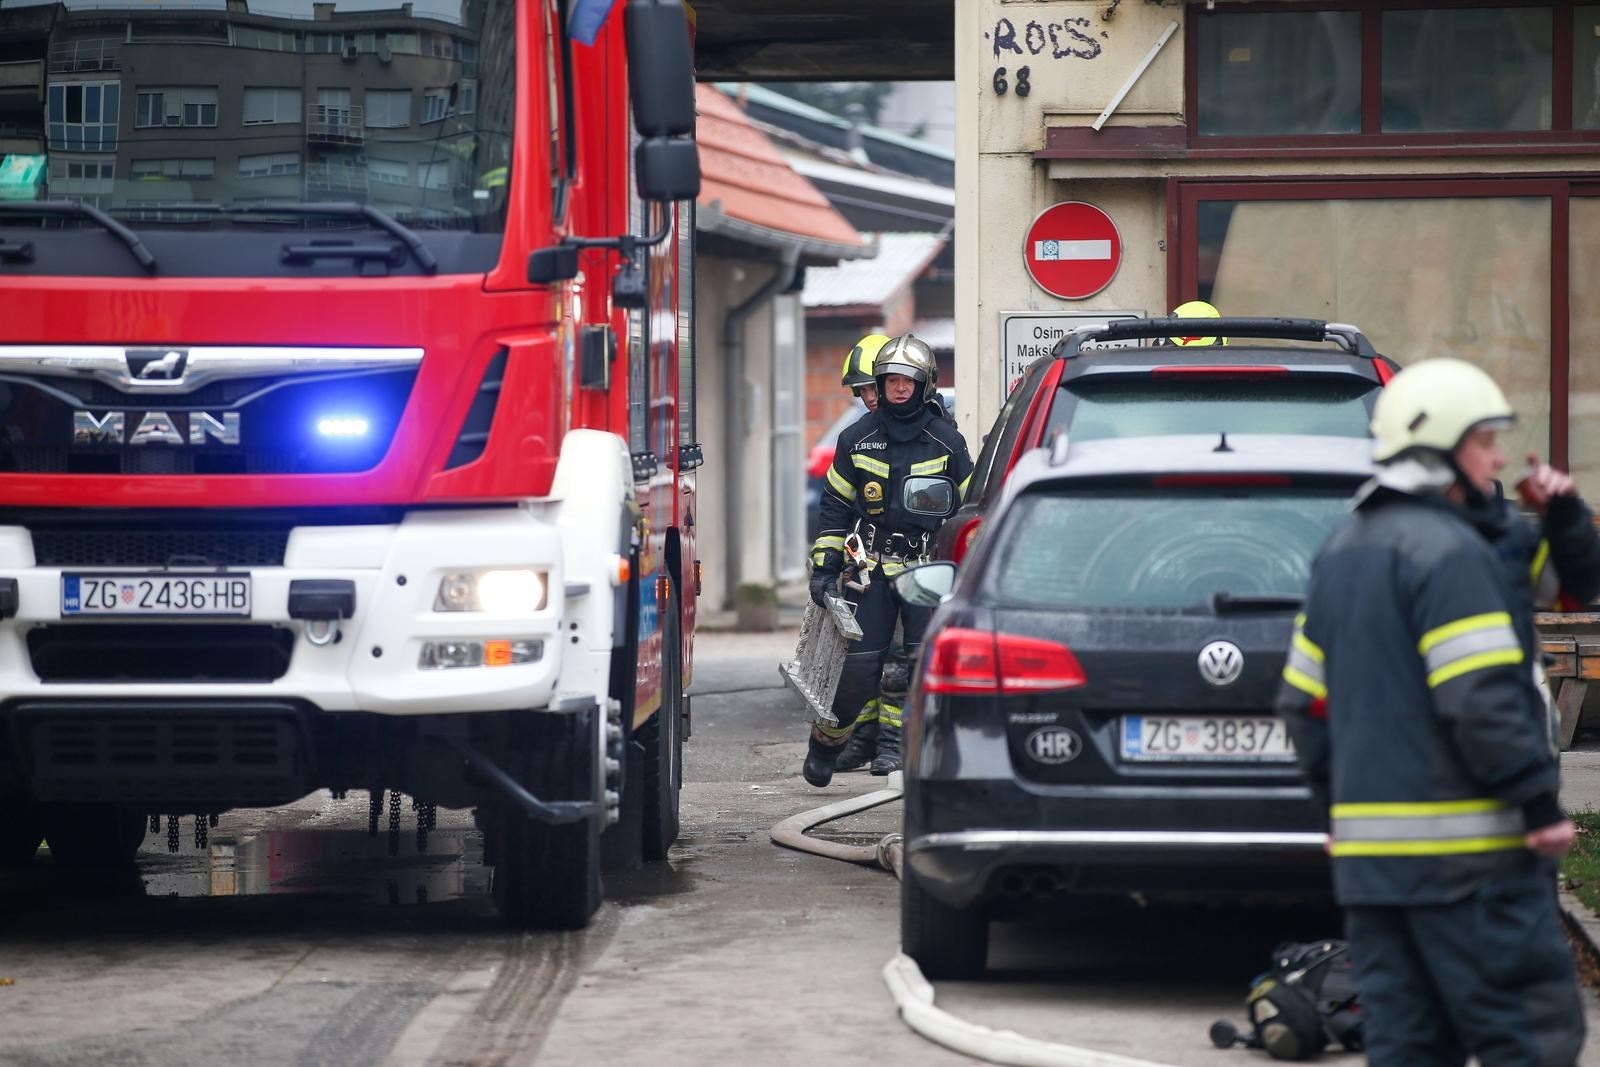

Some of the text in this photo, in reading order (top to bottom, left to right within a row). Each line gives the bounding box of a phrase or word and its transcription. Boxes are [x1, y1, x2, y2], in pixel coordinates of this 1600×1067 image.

[993, 65, 1031, 97] 68
[1033, 326, 1064, 339] Osim
[73, 411, 240, 444] MAN
[84, 580, 117, 609] ZG
[1036, 732, 1073, 757] HR
[1146, 720, 1181, 751] ZG
